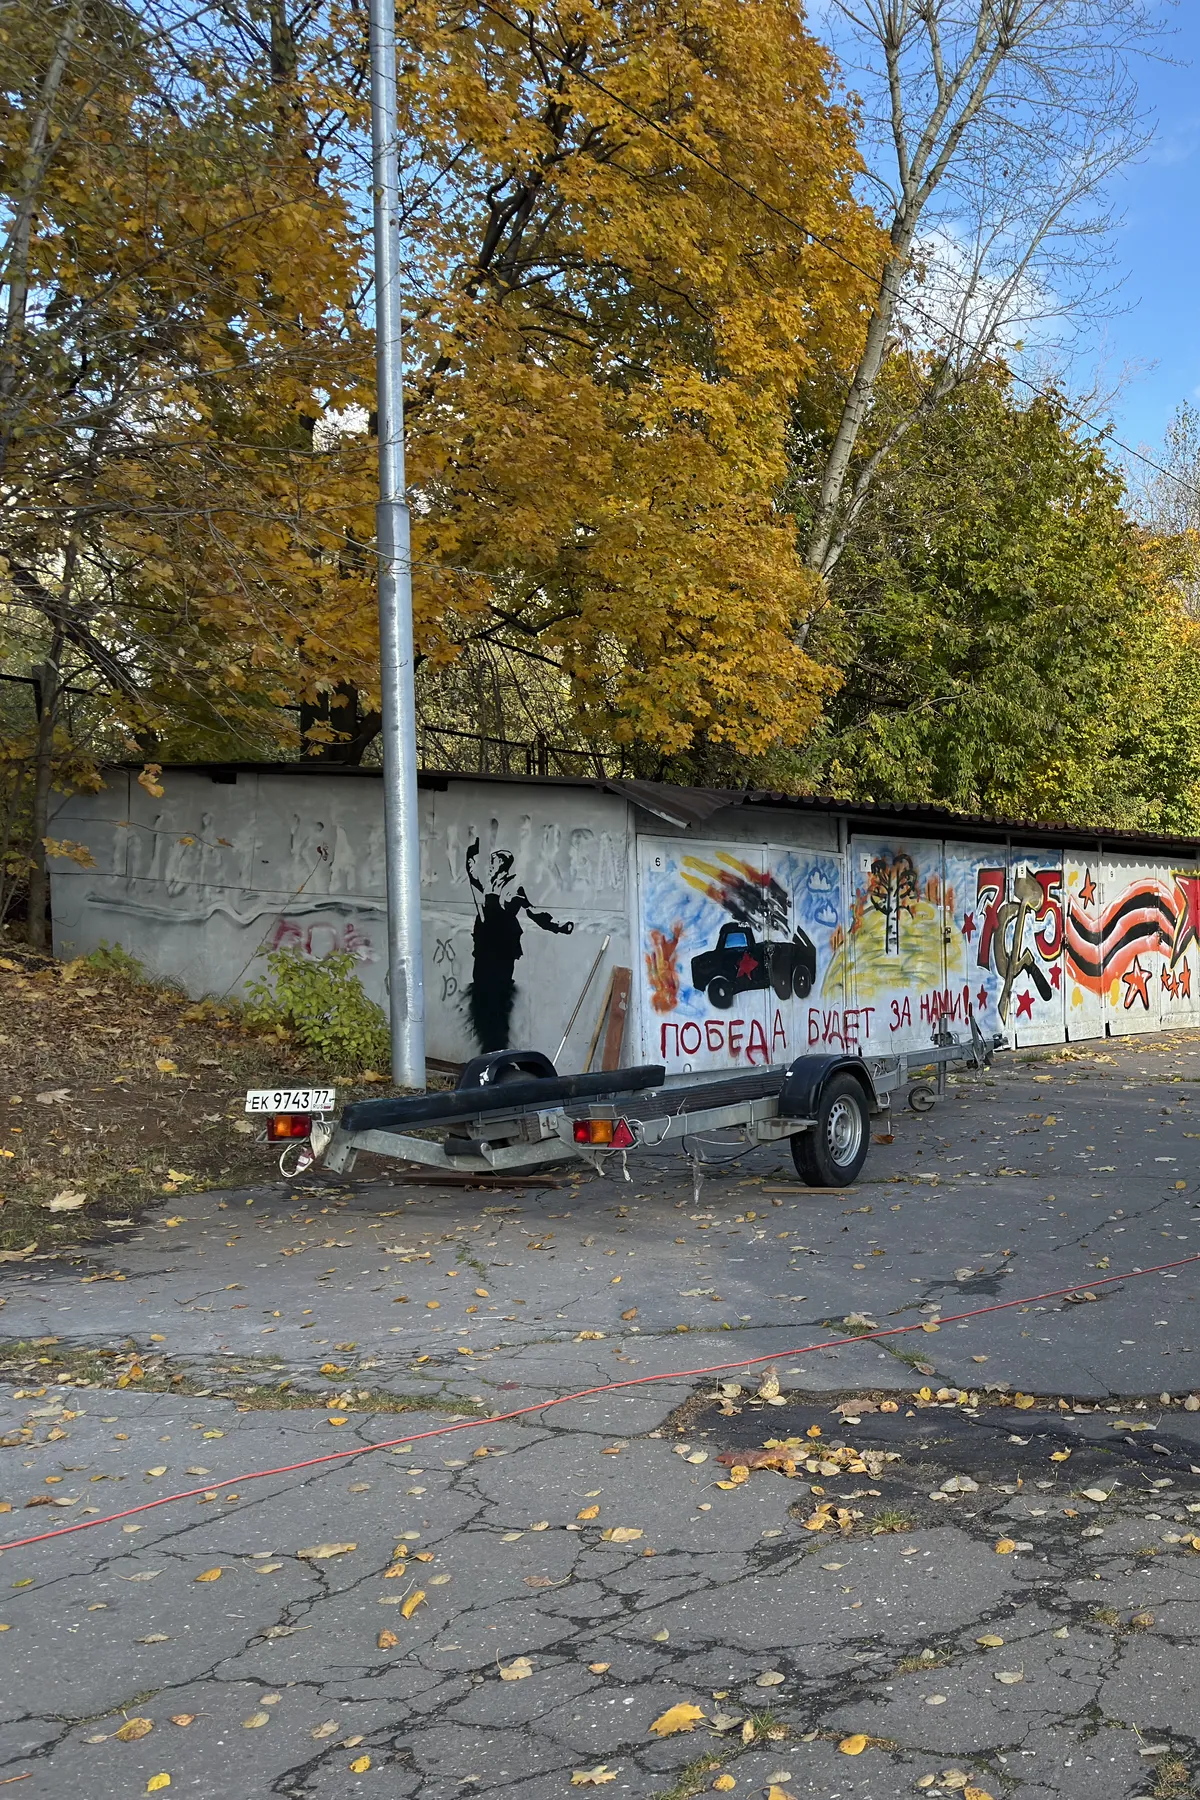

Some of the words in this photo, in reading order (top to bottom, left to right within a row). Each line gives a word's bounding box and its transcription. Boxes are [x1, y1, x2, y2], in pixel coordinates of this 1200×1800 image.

[655, 857, 661, 867] 6
[863, 858, 868, 868] 7
[661, 1009, 787, 1066] ПОБЕДА
[808, 1006, 875, 1050] БУДЕТ
[889, 996, 912, 1032] ЗА
[920, 984, 969, 1026] НАМИ!
[251, 1096, 269, 1110] ЕК
[273, 1092, 310, 1110] 9743
[314, 1090, 329, 1104] 77
